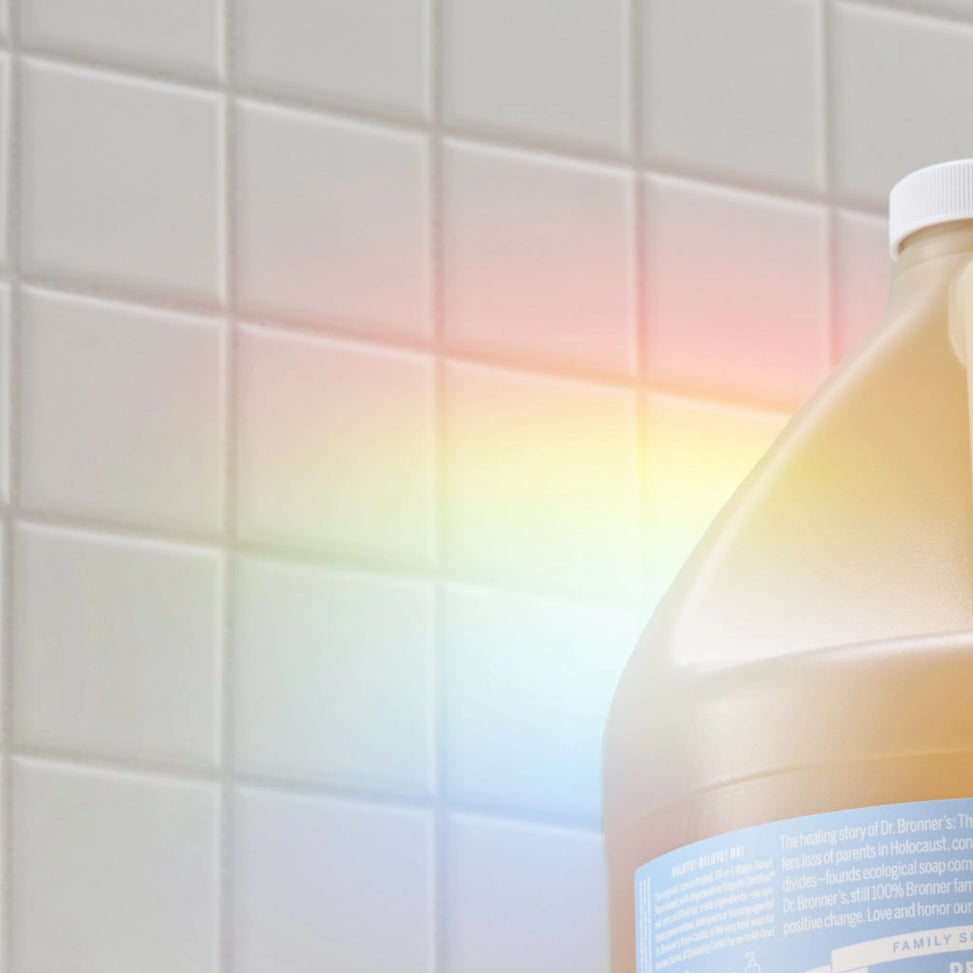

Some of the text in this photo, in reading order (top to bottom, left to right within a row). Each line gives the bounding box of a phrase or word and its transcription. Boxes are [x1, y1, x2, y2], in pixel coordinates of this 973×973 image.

[781, 834, 798, 851] The
[800, 831, 837, 846] healing
[839, 827, 864, 842] story
[868, 824, 880, 836] of
[881, 822, 895, 835] Dr.
[802, 852, 821, 867] loss
[824, 851, 834, 864] of
[836, 846, 876, 865] parents
[878, 843, 888, 858] in
[863, 862, 917, 883] ecological
[919, 861, 945, 878] soap
[851, 887, 869, 903] still
[871, 883, 904, 901] 100%
[907, 880, 951, 896] Bronner
[784, 916, 822, 935] positive
[824, 911, 864, 928] change.
[867, 907, 892, 922] Love
[894, 903, 916, 919] and
[917, 901, 950, 917] honor
[892, 933, 952, 953] FAMILY
